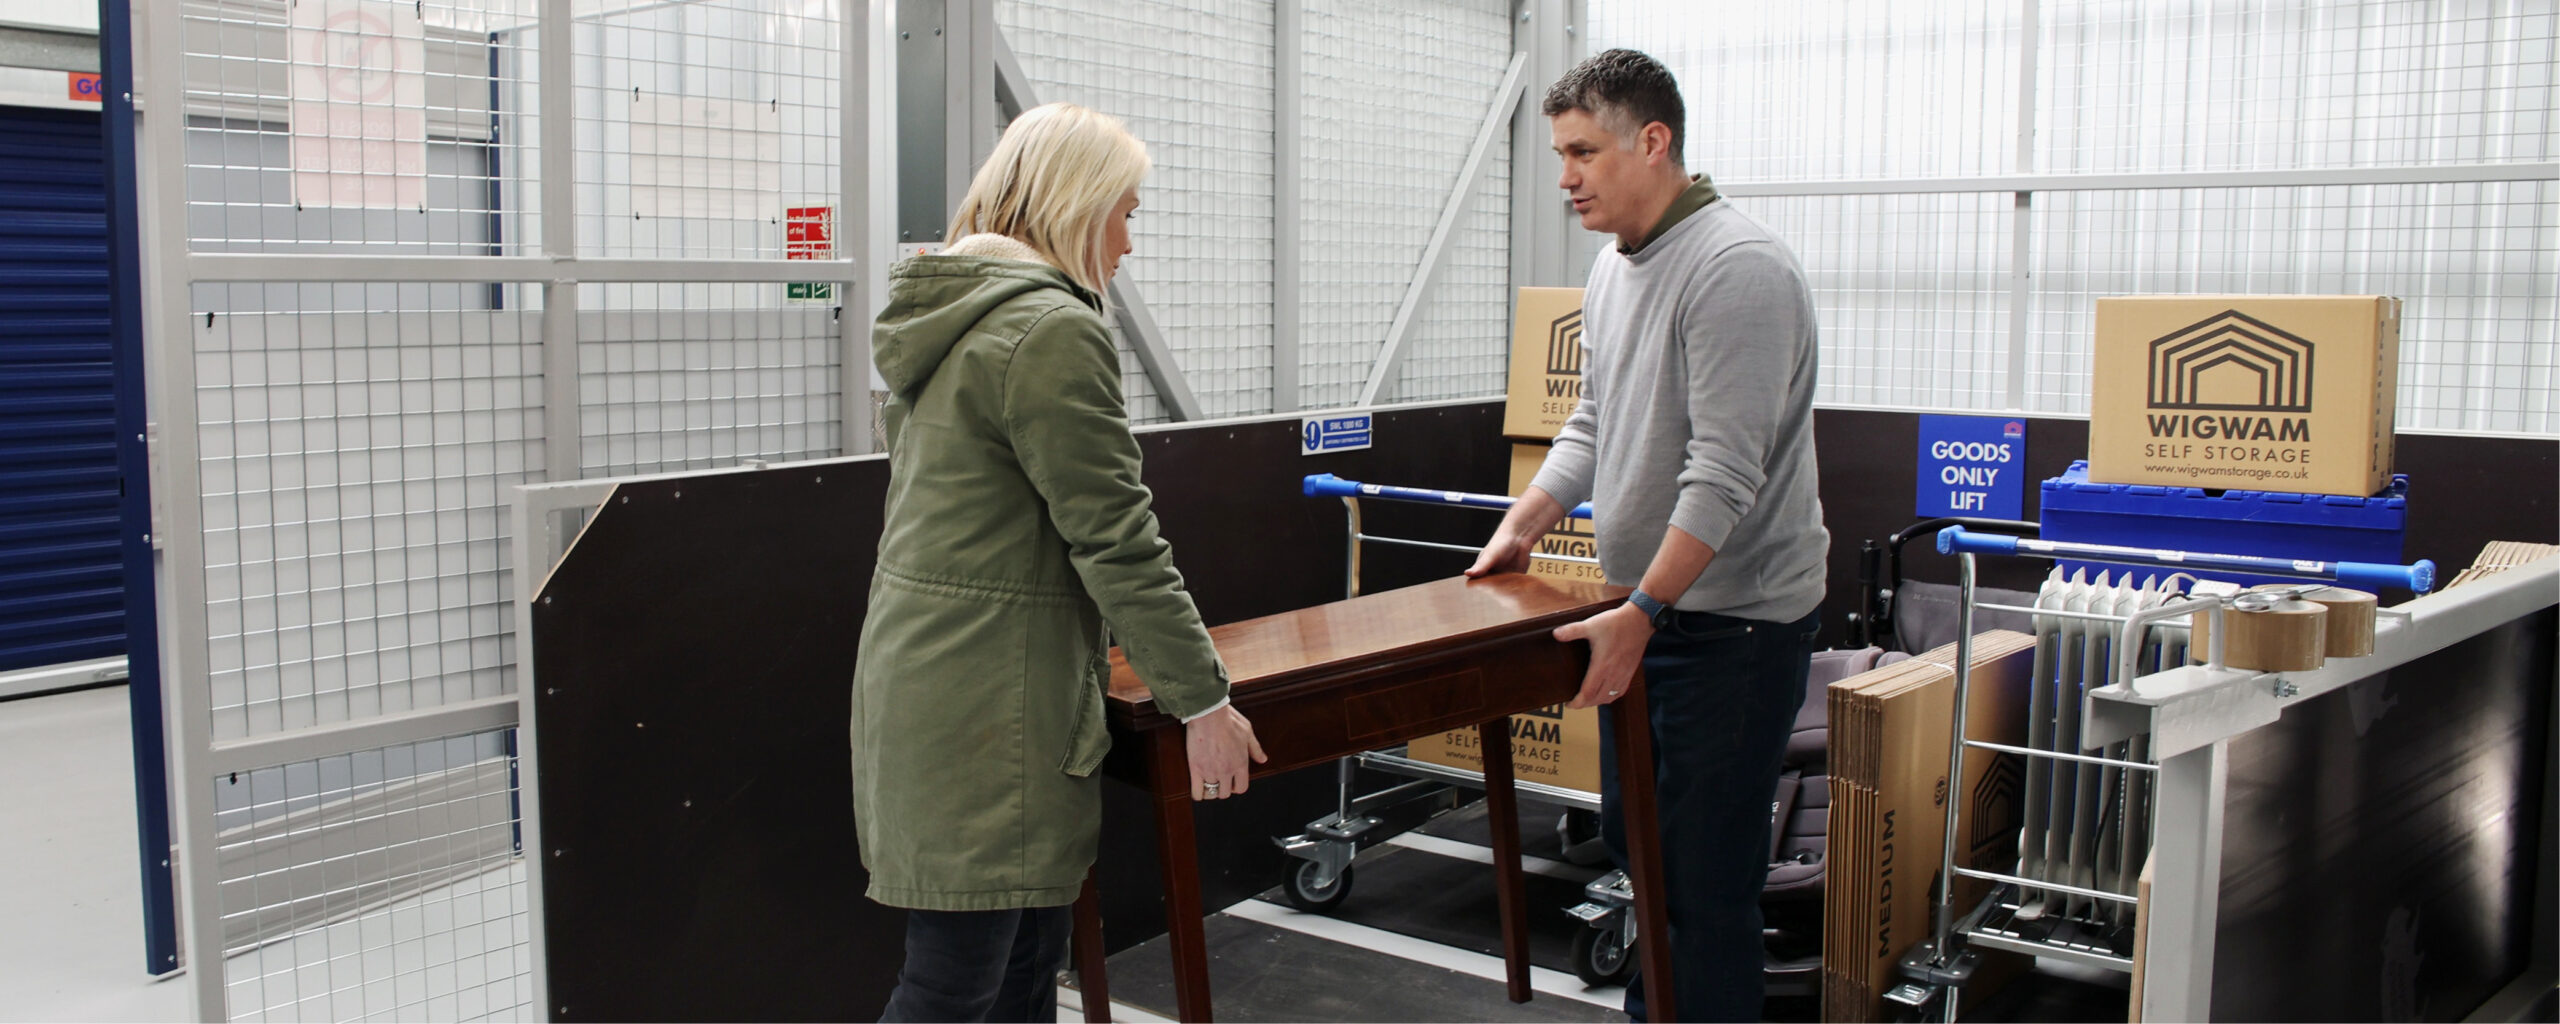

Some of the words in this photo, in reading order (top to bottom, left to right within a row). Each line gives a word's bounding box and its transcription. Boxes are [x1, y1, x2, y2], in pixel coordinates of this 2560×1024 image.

[1542, 402, 1574, 415] SELF
[2147, 414, 2311, 442] WIGWAM
[1931, 440, 2012, 463] GOODS
[2145, 443, 2192, 458] SELF
[2204, 445, 2311, 463] STORAGE
[1941, 465, 2000, 487] ONLY
[2145, 463, 2309, 480] www.wigwamstorage.co.uk
[1950, 490, 1988, 511] LIFT
[1537, 561, 1569, 575] SELF
[1446, 732, 1480, 748] SELF
[1878, 809, 1896, 959] MEDIUM
